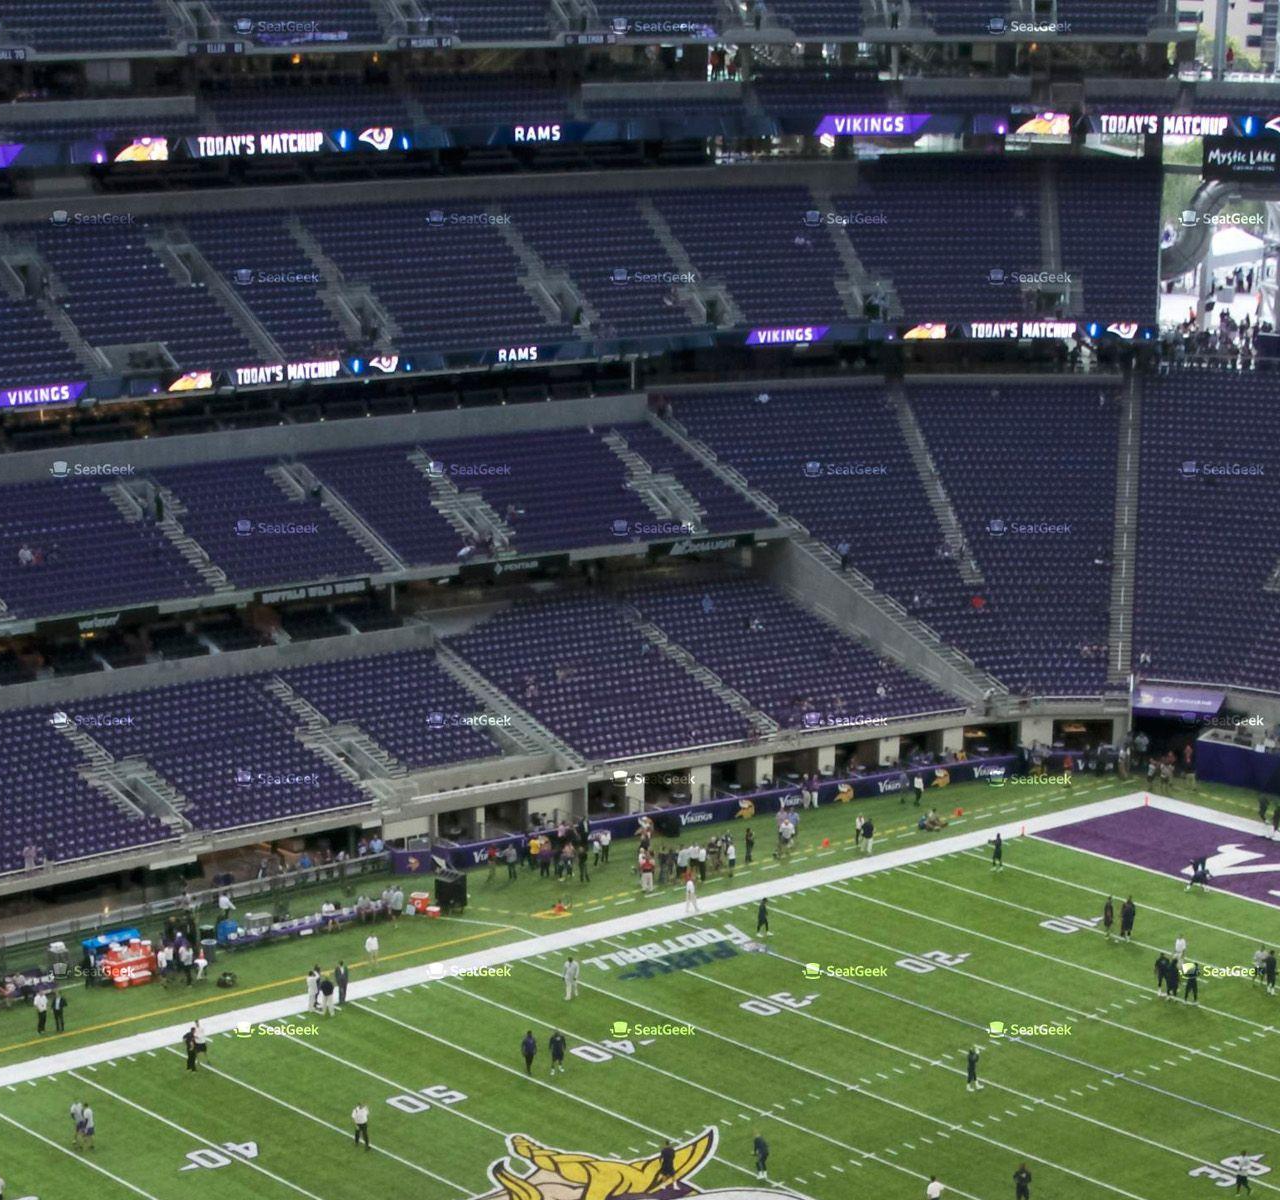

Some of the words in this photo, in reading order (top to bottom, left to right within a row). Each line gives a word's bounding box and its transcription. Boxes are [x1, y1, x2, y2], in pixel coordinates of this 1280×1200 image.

[834, 116, 904, 133] VIKINGS
[1100, 115, 1158, 134] TODAY'S
[1163, 115, 1228, 135] MATCHUP
[514, 125, 561, 142] RAMS
[197, 134, 255, 157] TODAY'S
[260, 132, 323, 154] MATCHUP
[758, 327, 813, 343] VIKINGS
[971, 322, 1018, 338] TODAY'S
[1022, 322, 1076, 339] MATCHUP
[498, 346, 537, 362] RAMS
[236, 365, 283, 385] TODAY'S
[287, 360, 340, 380] MATCHUP
[8, 385, 69, 406] VIKINGS
[503, 560, 538, 571] PENTAIR
[308, 584, 333, 599] WILD
[386, 1085, 468, 1113] 50
